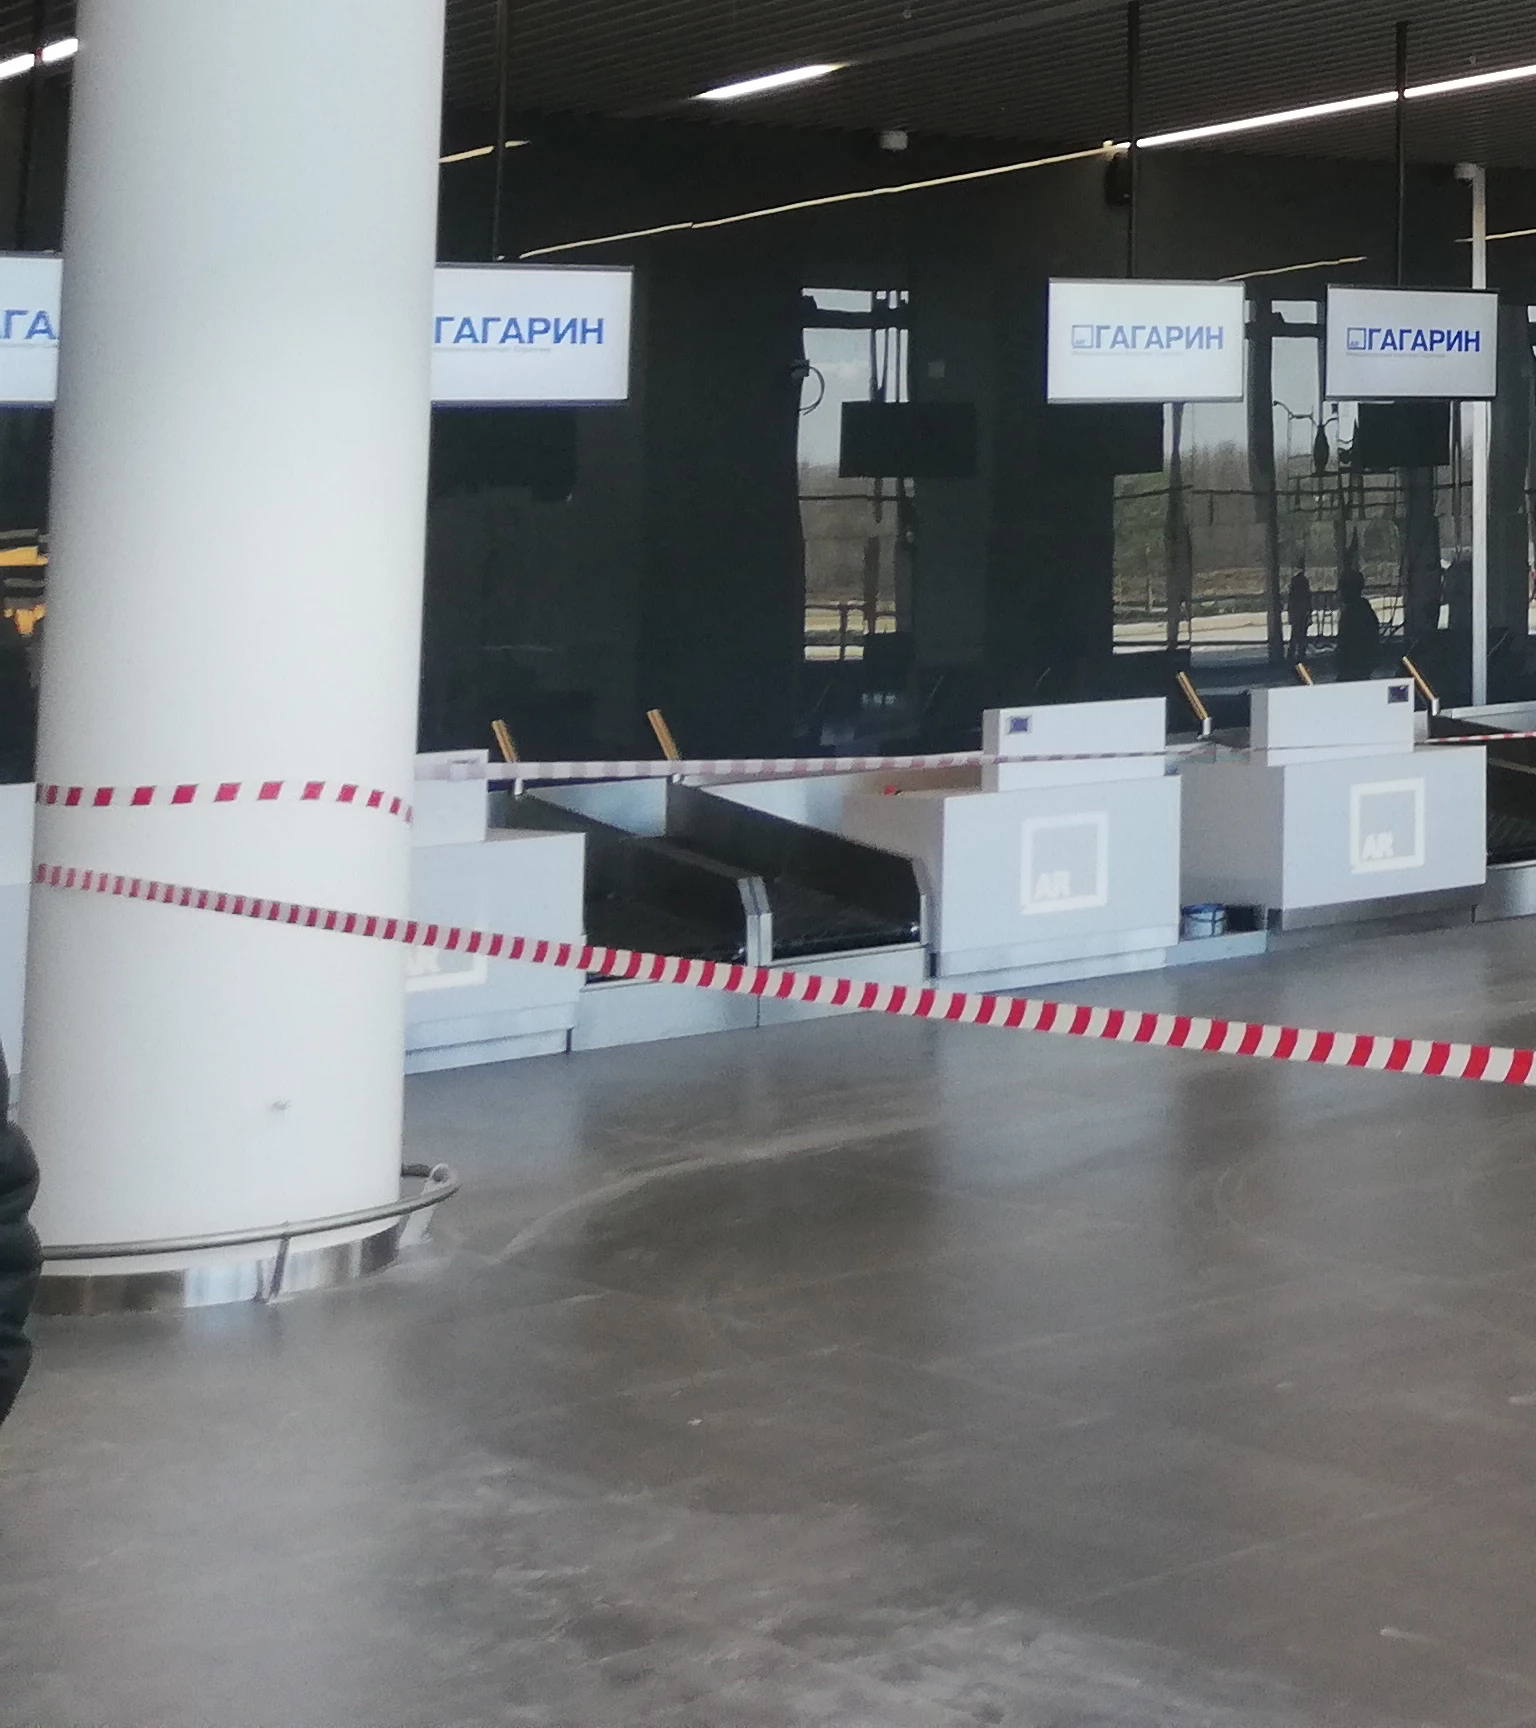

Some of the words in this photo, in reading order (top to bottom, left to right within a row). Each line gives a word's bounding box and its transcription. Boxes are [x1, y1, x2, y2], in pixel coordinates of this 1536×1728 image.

[434, 316, 604, 345] ГАГАРИН
[1095, 325, 1224, 350] ГАГАРИН
[1368, 328, 1480, 352] ГАГАРИН
